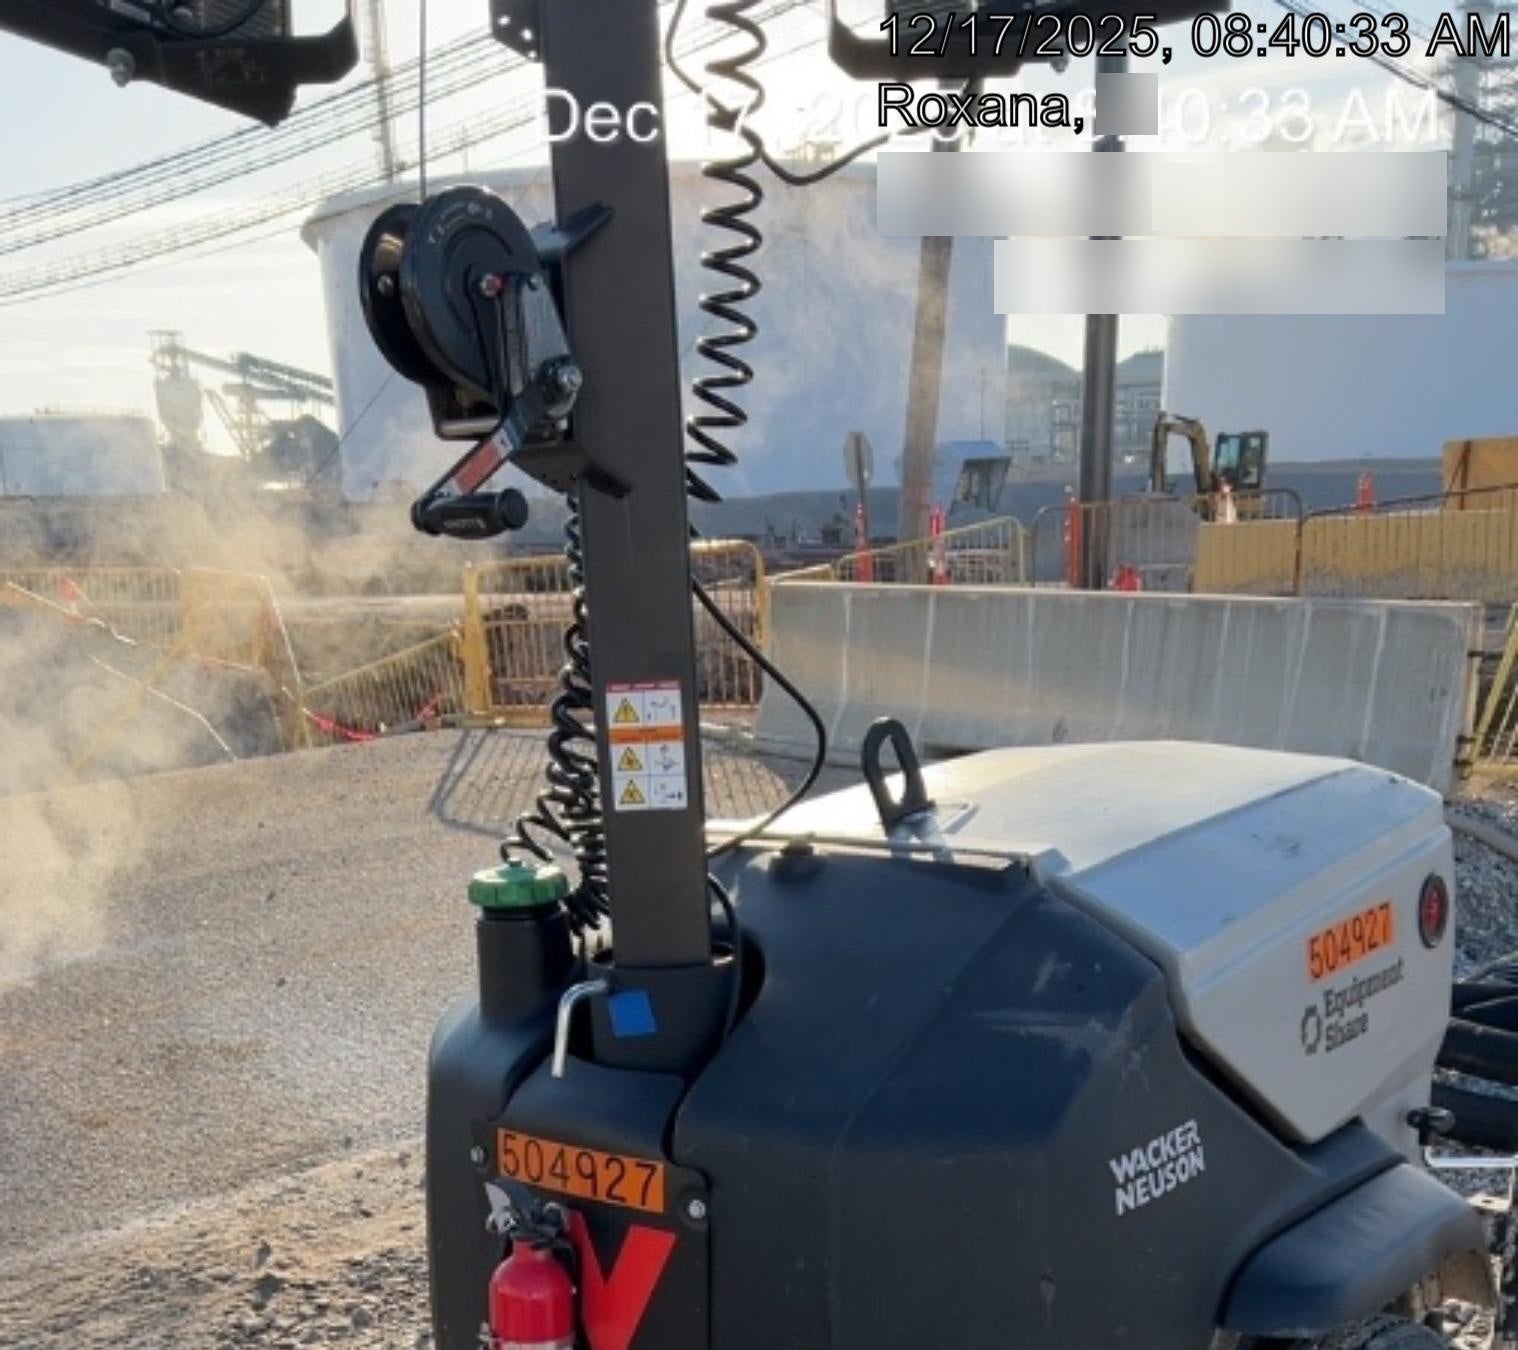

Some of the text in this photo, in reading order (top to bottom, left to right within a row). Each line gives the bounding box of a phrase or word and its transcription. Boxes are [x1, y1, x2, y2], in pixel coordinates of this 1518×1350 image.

[1310, 901, 1390, 979] 504927
[1323, 956, 1405, 1018] Equipment
[1324, 1013, 1369, 1053] Share
[502, 1133, 658, 1207] 504927
[1109, 1119, 1201, 1185] WACKER
[1115, 1145, 1205, 1217] NEUSON
